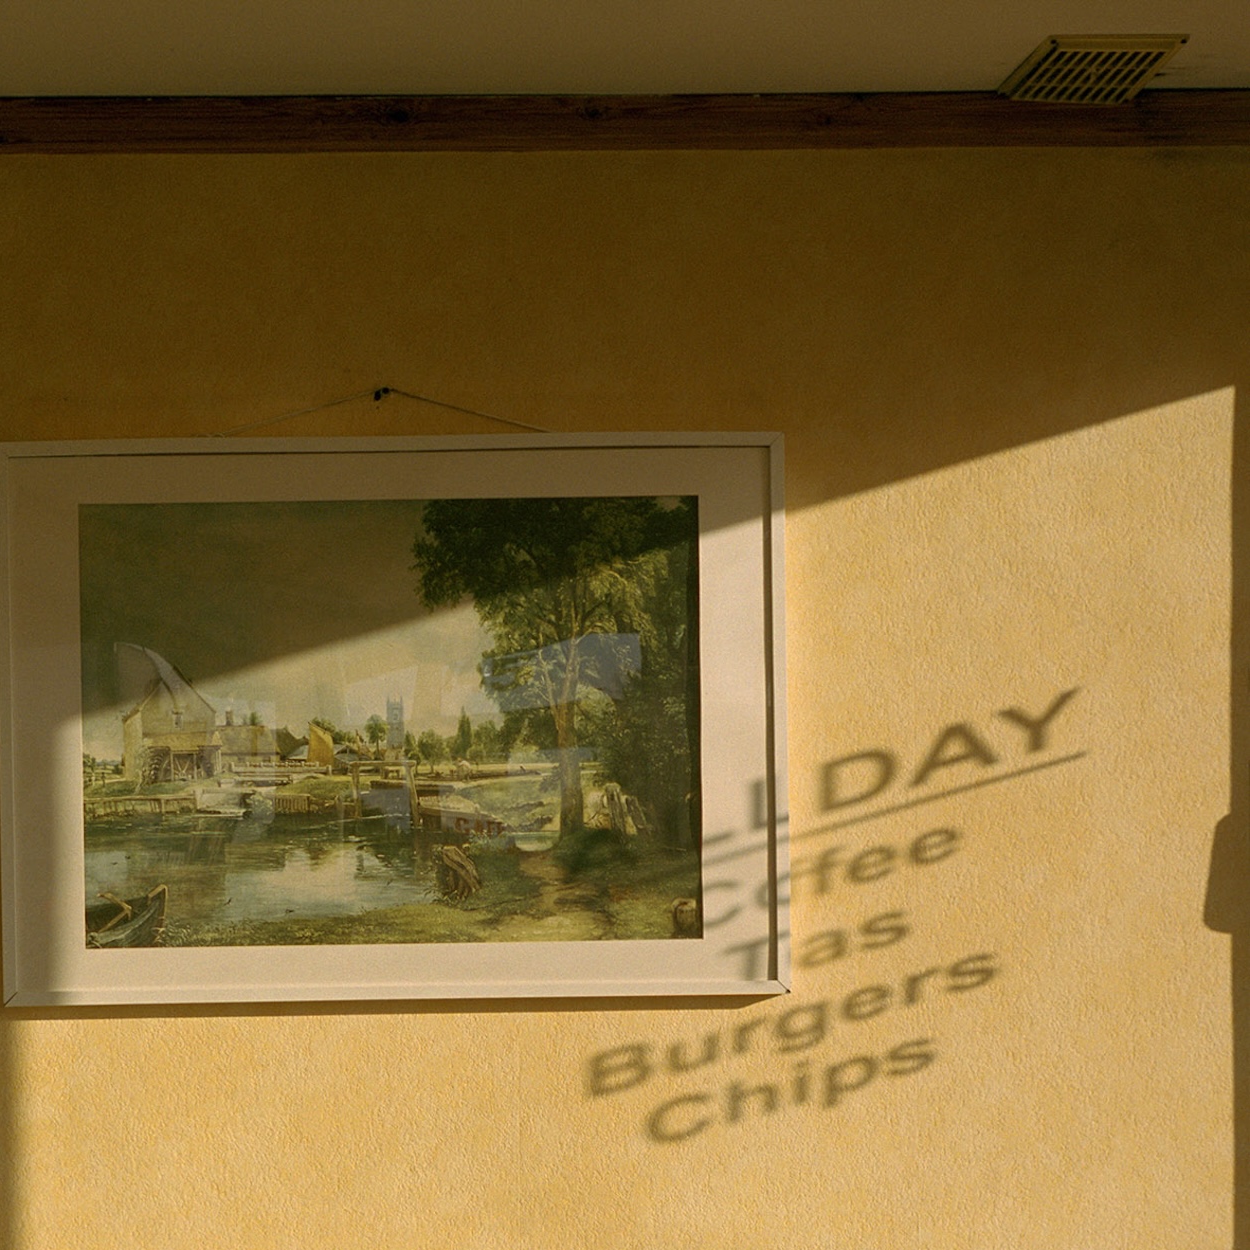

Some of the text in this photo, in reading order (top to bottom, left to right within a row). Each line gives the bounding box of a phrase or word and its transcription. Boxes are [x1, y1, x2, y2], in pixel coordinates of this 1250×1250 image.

[818, 686, 1081, 813] DAY
[720, 908, 912, 982] Tas
[586, 950, 1000, 1101] Burgers
[644, 1036, 939, 1146] Chips
